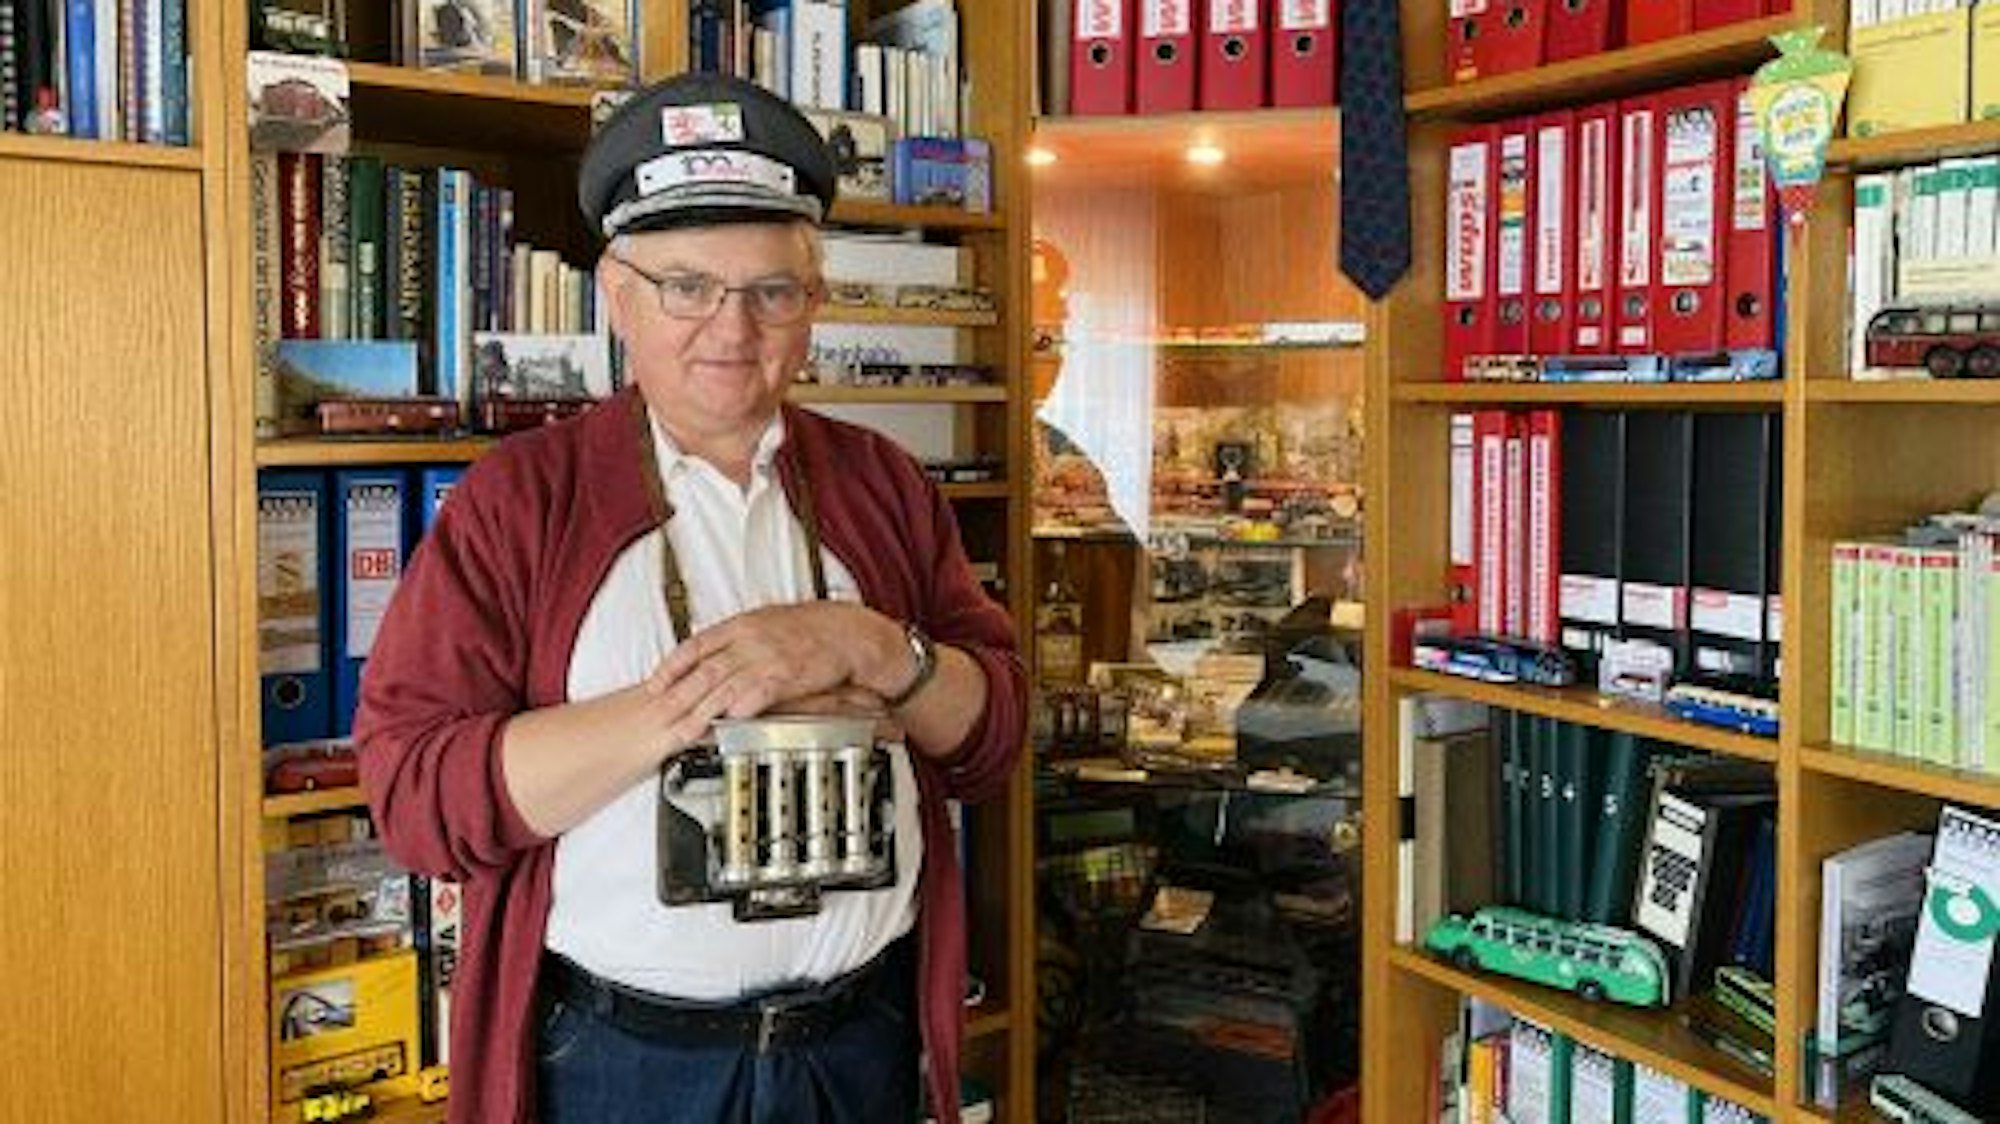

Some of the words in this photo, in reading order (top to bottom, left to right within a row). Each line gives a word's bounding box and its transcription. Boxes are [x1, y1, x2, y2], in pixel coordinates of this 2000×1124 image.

[1541, 774, 1552, 798] 3
[1562, 782, 1574, 802] 4
[1604, 794, 1618, 815] 5
